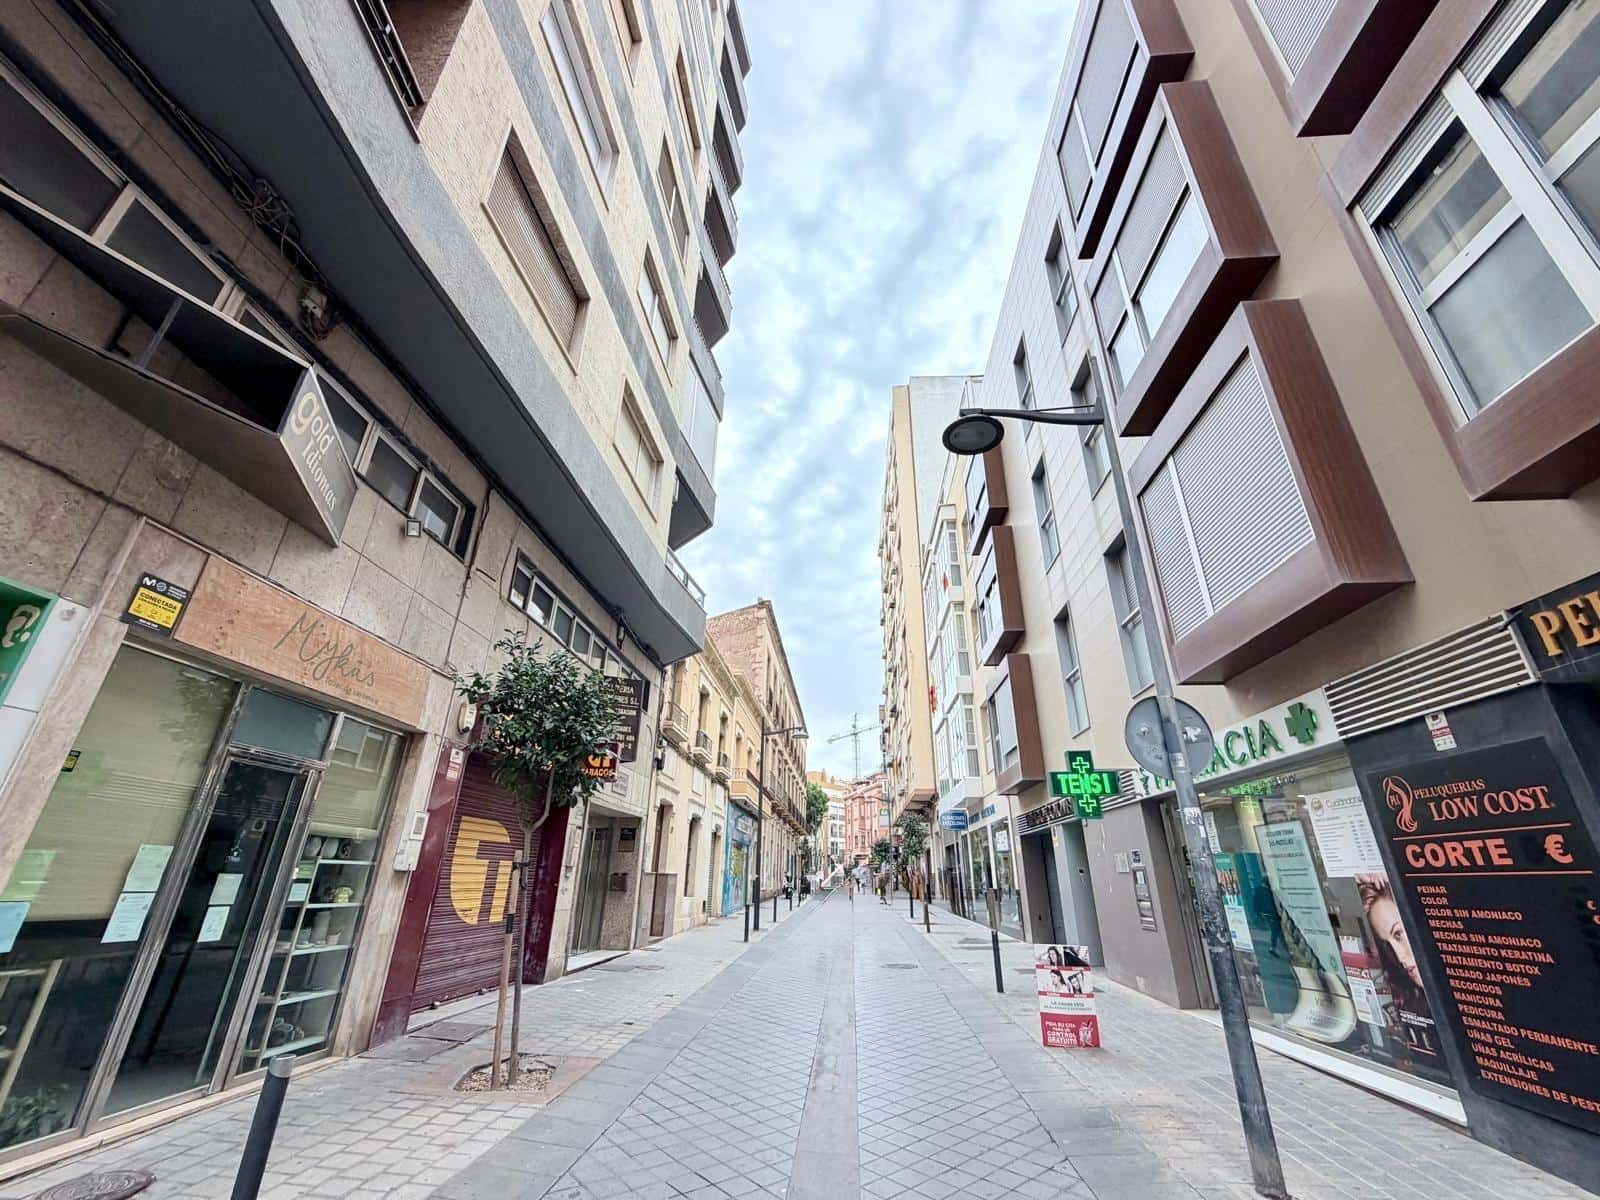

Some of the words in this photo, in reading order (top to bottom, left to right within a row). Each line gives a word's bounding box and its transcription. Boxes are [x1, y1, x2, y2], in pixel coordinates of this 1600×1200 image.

[291, 391, 334, 456] gold
[302, 435, 337, 512] Idiomas
[139, 592, 178, 610] CONECTADA
[1413, 778, 1486, 800] PELUQUERIAS
[1428, 794, 1478, 821] LOW
[1483, 785, 1551, 815] COST
[1405, 838, 1514, 869] CORTE
[1543, 833, 1574, 864] €
[1416, 885, 1447, 894] PEINAR
[1420, 896, 1449, 905] COLOR
[1424, 908, 1452, 917] COLOR
[1453, 909, 1470, 918] SIN
[1471, 910, 1523, 921] AMONIACO
[1428, 919, 1464, 929] MECHAS
[1432, 930, 1469, 942] MECHAS
[1469, 934, 1486, 943] SIN
[1487, 935, 1542, 949] AMONIACO
[1436, 942, 1499, 957] TRATAMIENTO
[1500, 948, 1555, 964] KERATINA
[1440, 954, 1504, 971] TRATAMIENTO
[1504, 962, 1542, 975] BOTOX
[1445, 967, 1484, 980] ALISADO
[1449, 978, 1503, 995] RECOGIDOS
[1452, 991, 1504, 1008] MANICURA
[1457, 1003, 1506, 1021] PEDICURA
[1461, 1015, 1519, 1036] ESMALTADO
[1519, 1028, 1599, 1055] PERMANENTE
[1493, 1035, 1515, 1049] GEL
[1475, 1056, 1539, 1081] MAQUILLAJE
[1480, 1069, 1551, 1099] EXTENSIONES
[1551, 1090, 1569, 1104] DE
